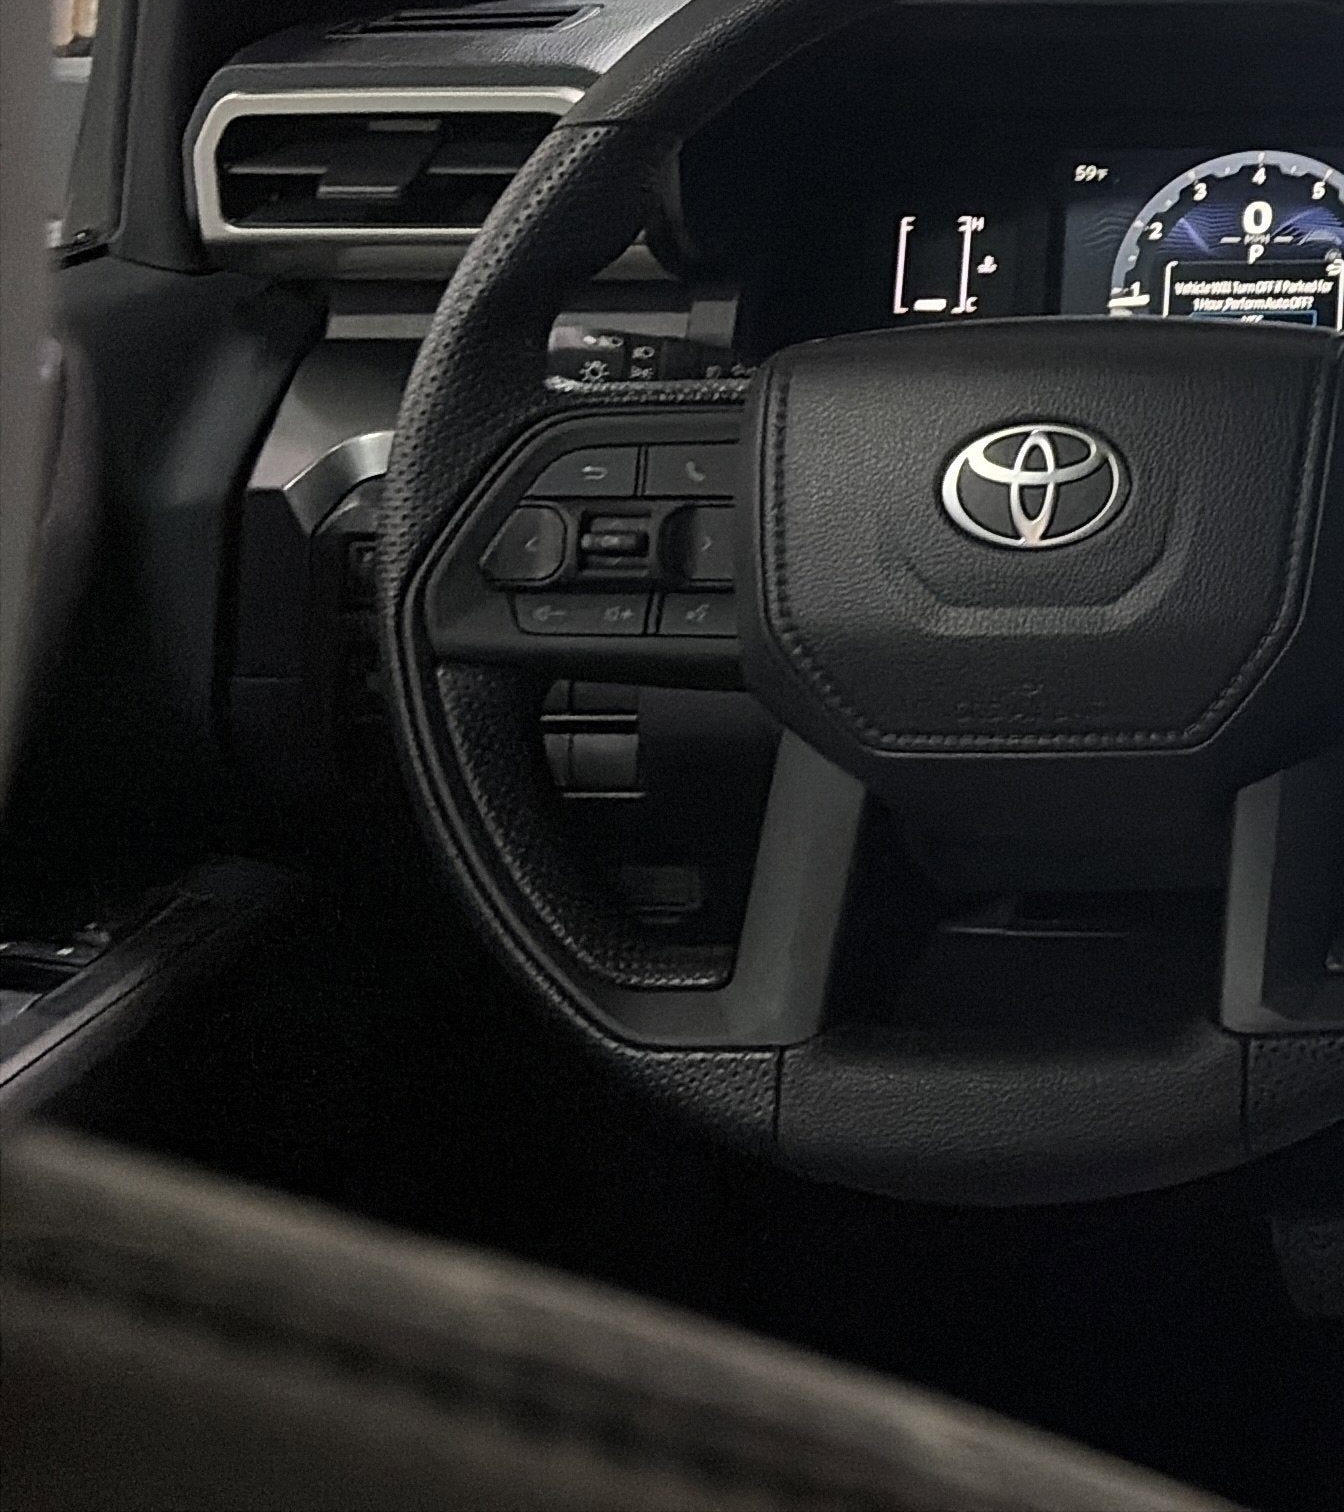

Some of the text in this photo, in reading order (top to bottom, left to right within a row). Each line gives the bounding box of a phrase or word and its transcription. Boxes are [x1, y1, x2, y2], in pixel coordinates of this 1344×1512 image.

[1252, 167, 1267, 186] 4
[1193, 182, 1208, 201] 3
[1311, 181, 1326, 200] 5
[1242, 201, 1273, 234] 0
[1147, 222, 1163, 240] 2
[1247, 244, 1265, 265] P
[1129, 282, 1141, 296] 1
[1175, 281, 1210, 295] Vehicle
[1233, 280, 1256, 294] Turn
[1283, 280, 1317, 293] Parked
[1317, 279, 1334, 293] for
[966, 296, 978, 312] C
